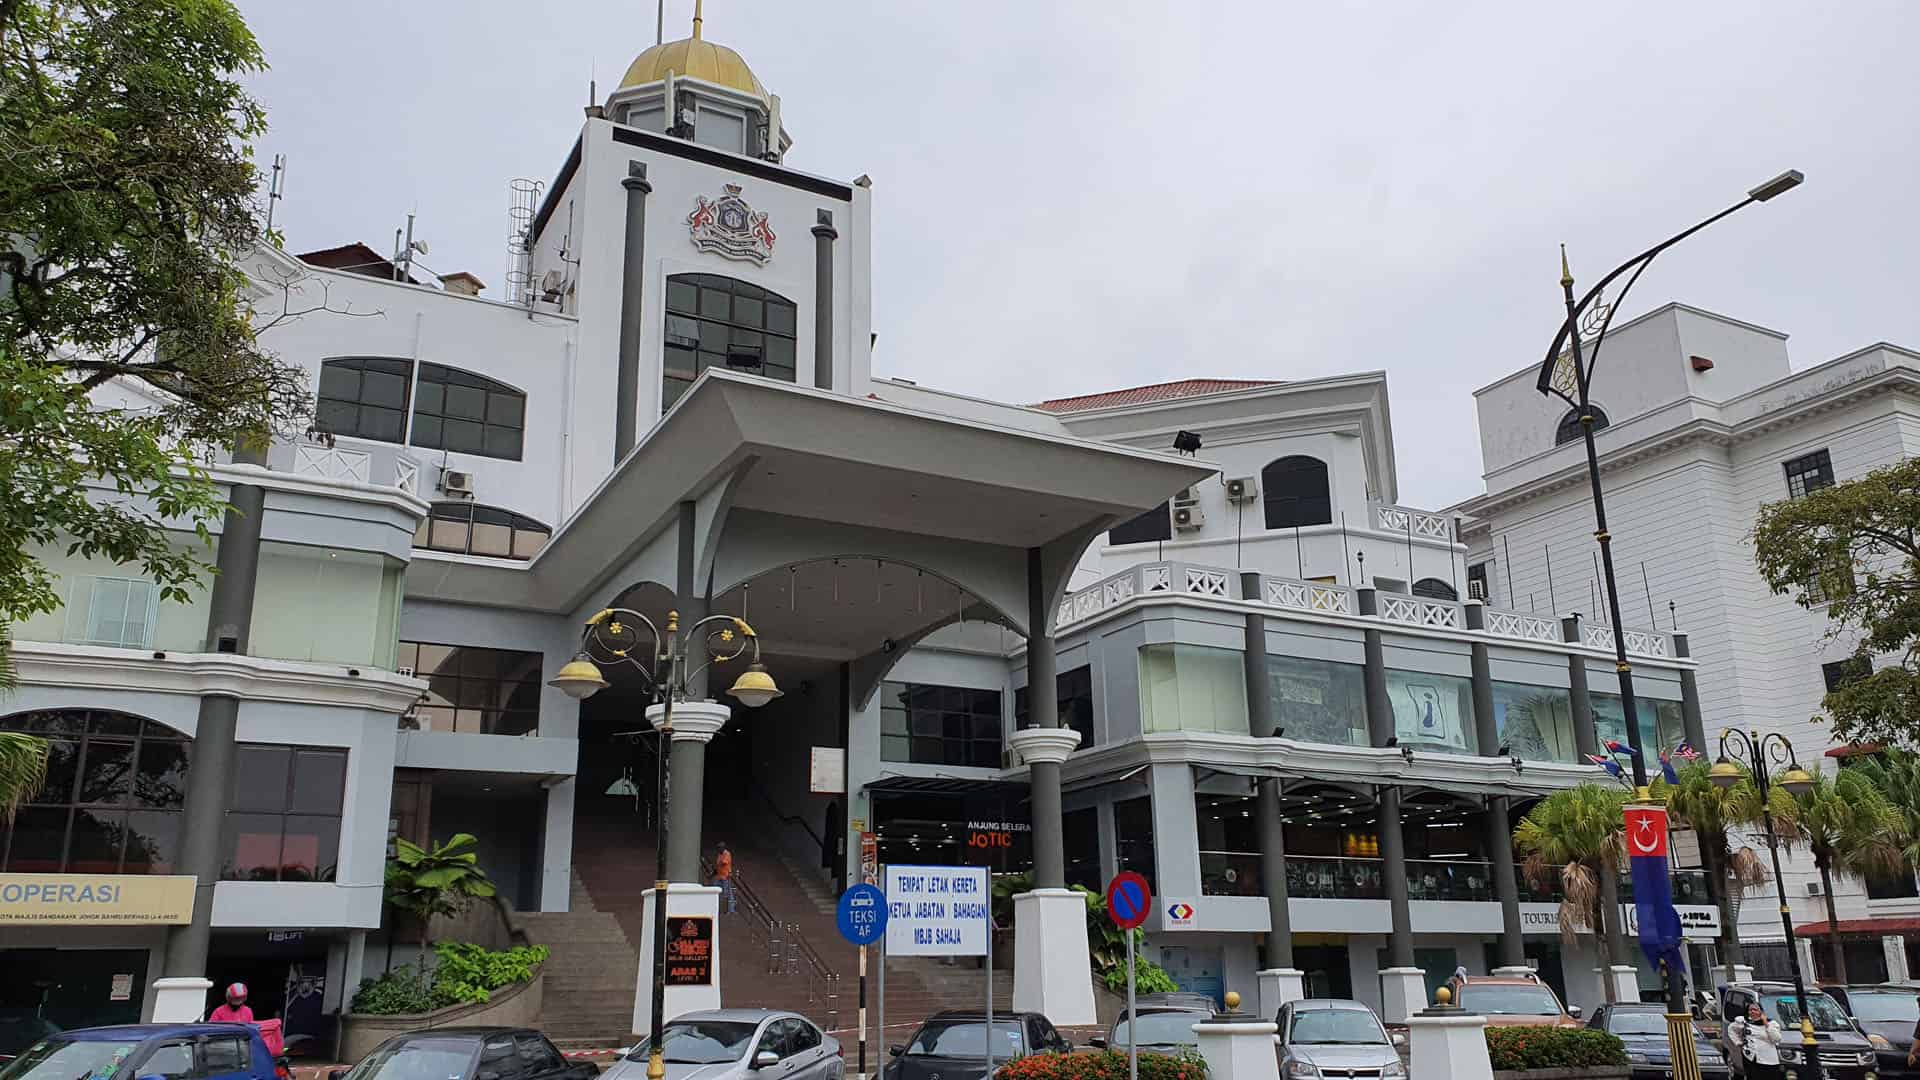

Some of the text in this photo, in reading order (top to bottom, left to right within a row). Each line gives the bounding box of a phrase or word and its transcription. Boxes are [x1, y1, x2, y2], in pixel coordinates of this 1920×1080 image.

[967, 821, 1000, 830] ANJUNG
[968, 831, 1013, 848] JOTIC
[0, 884, 120, 903] OPERASI
[898, 876, 977, 894] TEMPAT LETAK KERETA
[850, 911, 877, 923] TEKSI
[888, 903, 986, 920] KETUA JABATAN BAHAGIAN
[914, 928, 961, 944] MBJB SAHAJA
